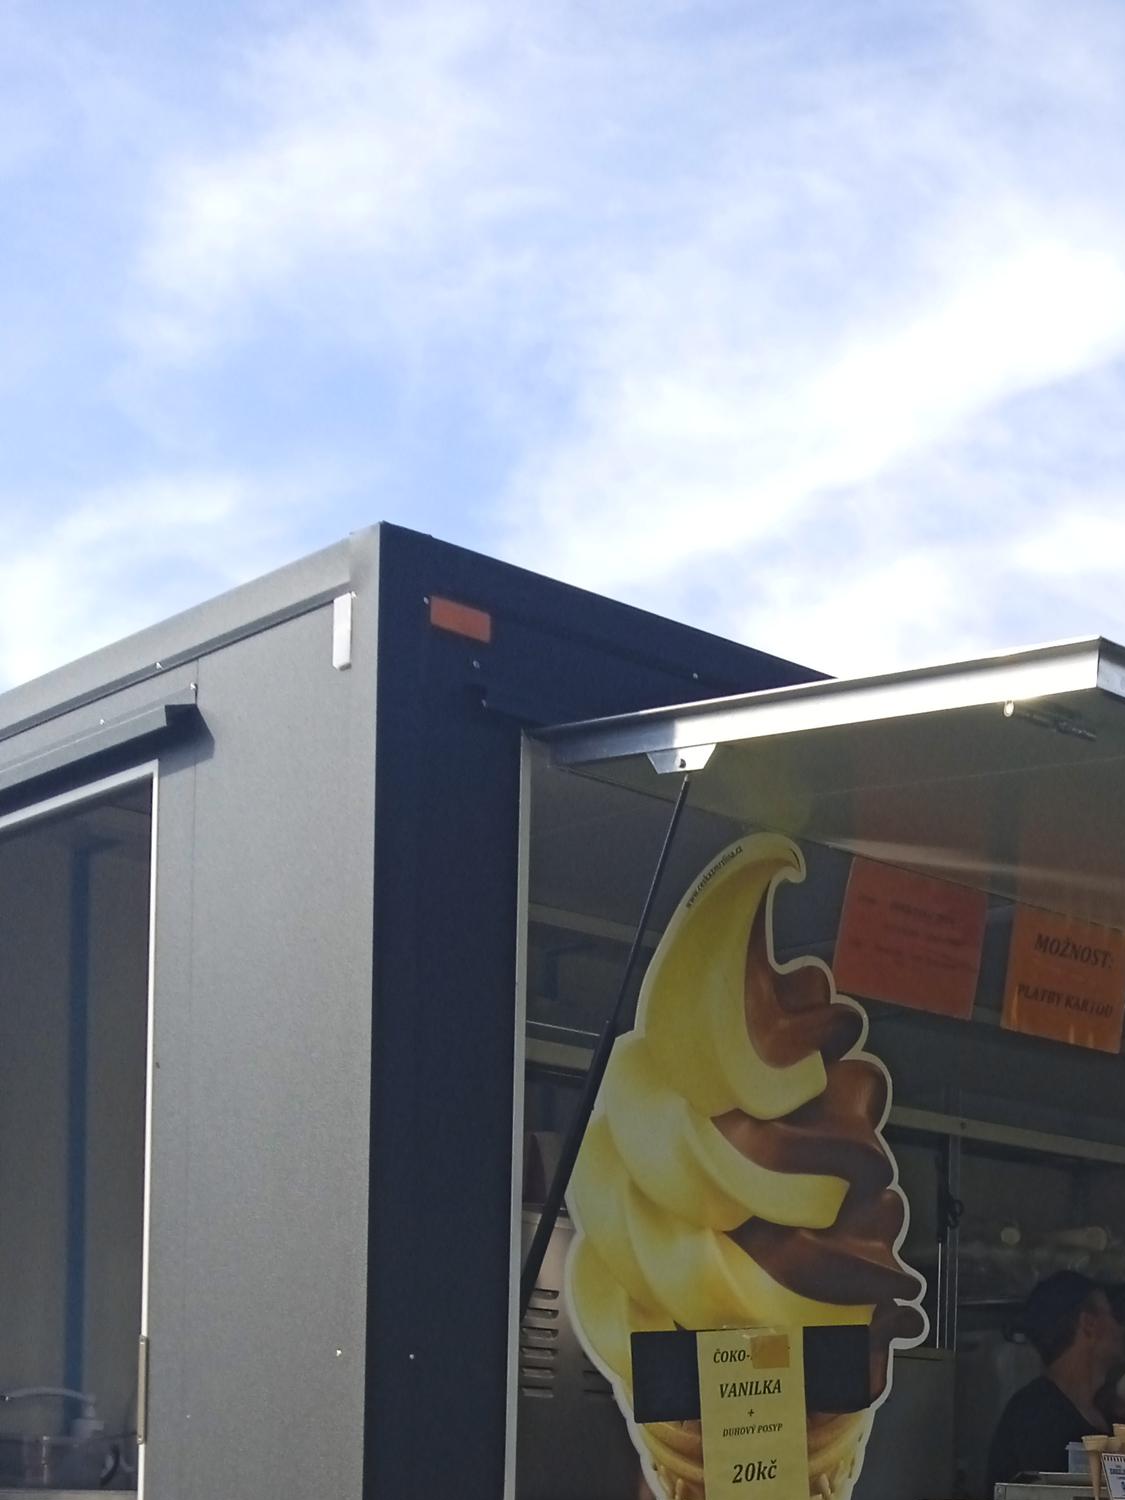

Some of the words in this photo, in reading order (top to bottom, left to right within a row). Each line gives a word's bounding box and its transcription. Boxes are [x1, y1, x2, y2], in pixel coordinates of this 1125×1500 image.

[1034, 933, 1114, 969] MOŽNOST:
[713, 1348, 753, 1364] ČOKO-
[719, 1378, 782, 1399] VANILKA
[722, 1424, 756, 1438] DUHOVÝ
[757, 1423, 783, 1434] POSYP
[732, 1460, 777, 1485] 20kč
